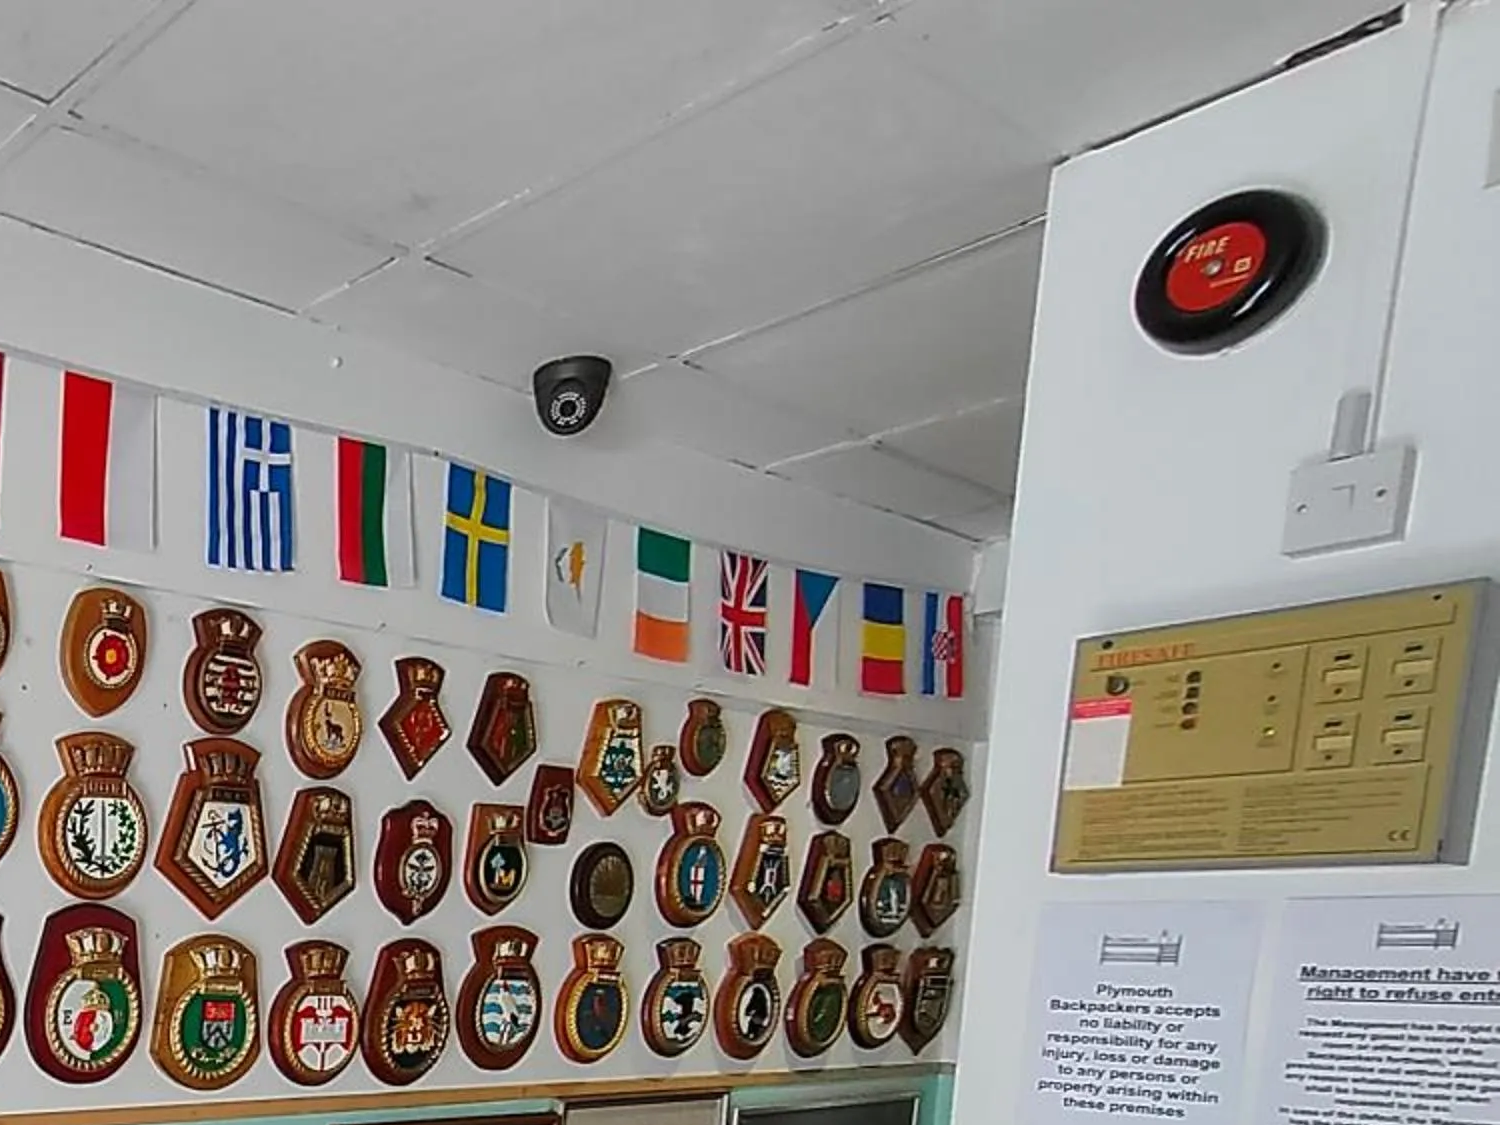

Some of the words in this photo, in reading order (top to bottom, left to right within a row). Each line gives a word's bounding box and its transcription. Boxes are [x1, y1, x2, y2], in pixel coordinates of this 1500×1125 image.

[1184, 236, 1231, 263] FIRE
[1300, 966, 1431, 983] Management
[1437, 967, 1491, 981] have
[1096, 984, 1173, 999] Plymouth
[1306, 986, 1354, 1000] right
[1359, 987, 1380, 998] to
[1385, 988, 1453, 1001] refuse
[1050, 998, 1151, 1014] Backpackers
[1154, 1004, 1221, 1018] accepts
[1079, 1019, 1099, 1028] no
[1103, 1018, 1162, 1034] liability
[1165, 1023, 1185, 1033] or
[1047, 1033, 1152, 1050] responsibility
[1158, 1038, 1183, 1050] for
[1186, 1041, 1217, 1054] any
[1093, 1050, 1127, 1063] loss
[1131, 1055, 1149, 1065] or
[1153, 1055, 1221, 1072] damage
[1057, 1064, 1073, 1076] to
[1077, 1067, 1106, 1080] any
[1109, 1069, 1177, 1084] persons
[1181, 1075, 1201, 1085] or
[1037, 1080, 1103, 1096] property
[1106, 1085, 1163, 1101] arising
[1167, 1090, 1220, 1104] within
[1063, 1096, 1105, 1110] these
[1109, 1102, 1186, 1118] premises
